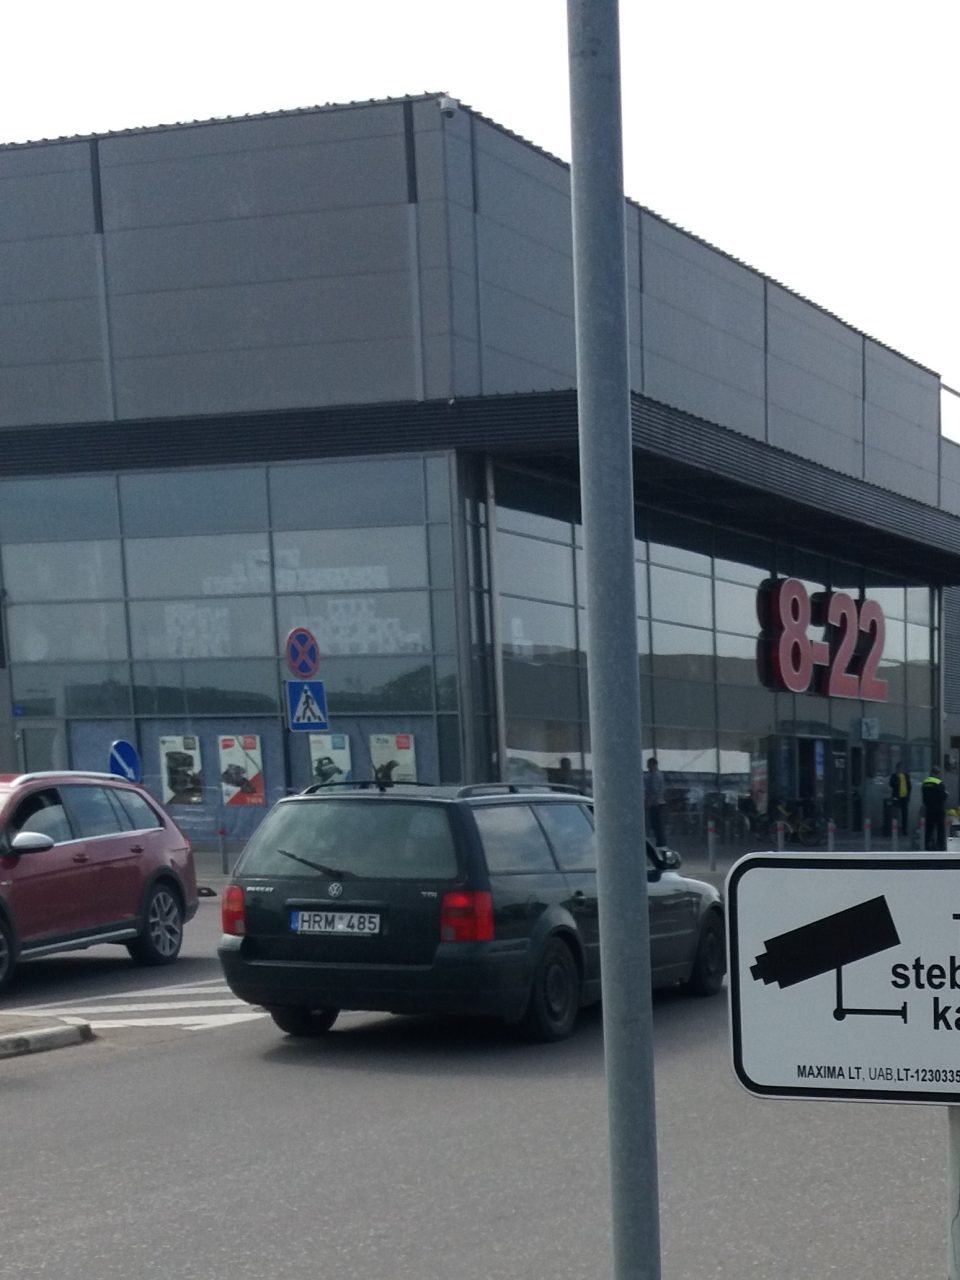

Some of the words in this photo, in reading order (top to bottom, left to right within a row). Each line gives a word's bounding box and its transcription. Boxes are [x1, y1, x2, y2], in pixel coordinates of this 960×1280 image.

[778, 577, 888, 703] 8-22
[301, 913, 336, 929] HRM
[346, 915, 378, 931] 485
[797, 1065, 845, 1080] MAXIMA
[848, 1067, 865, 1082] LT,
